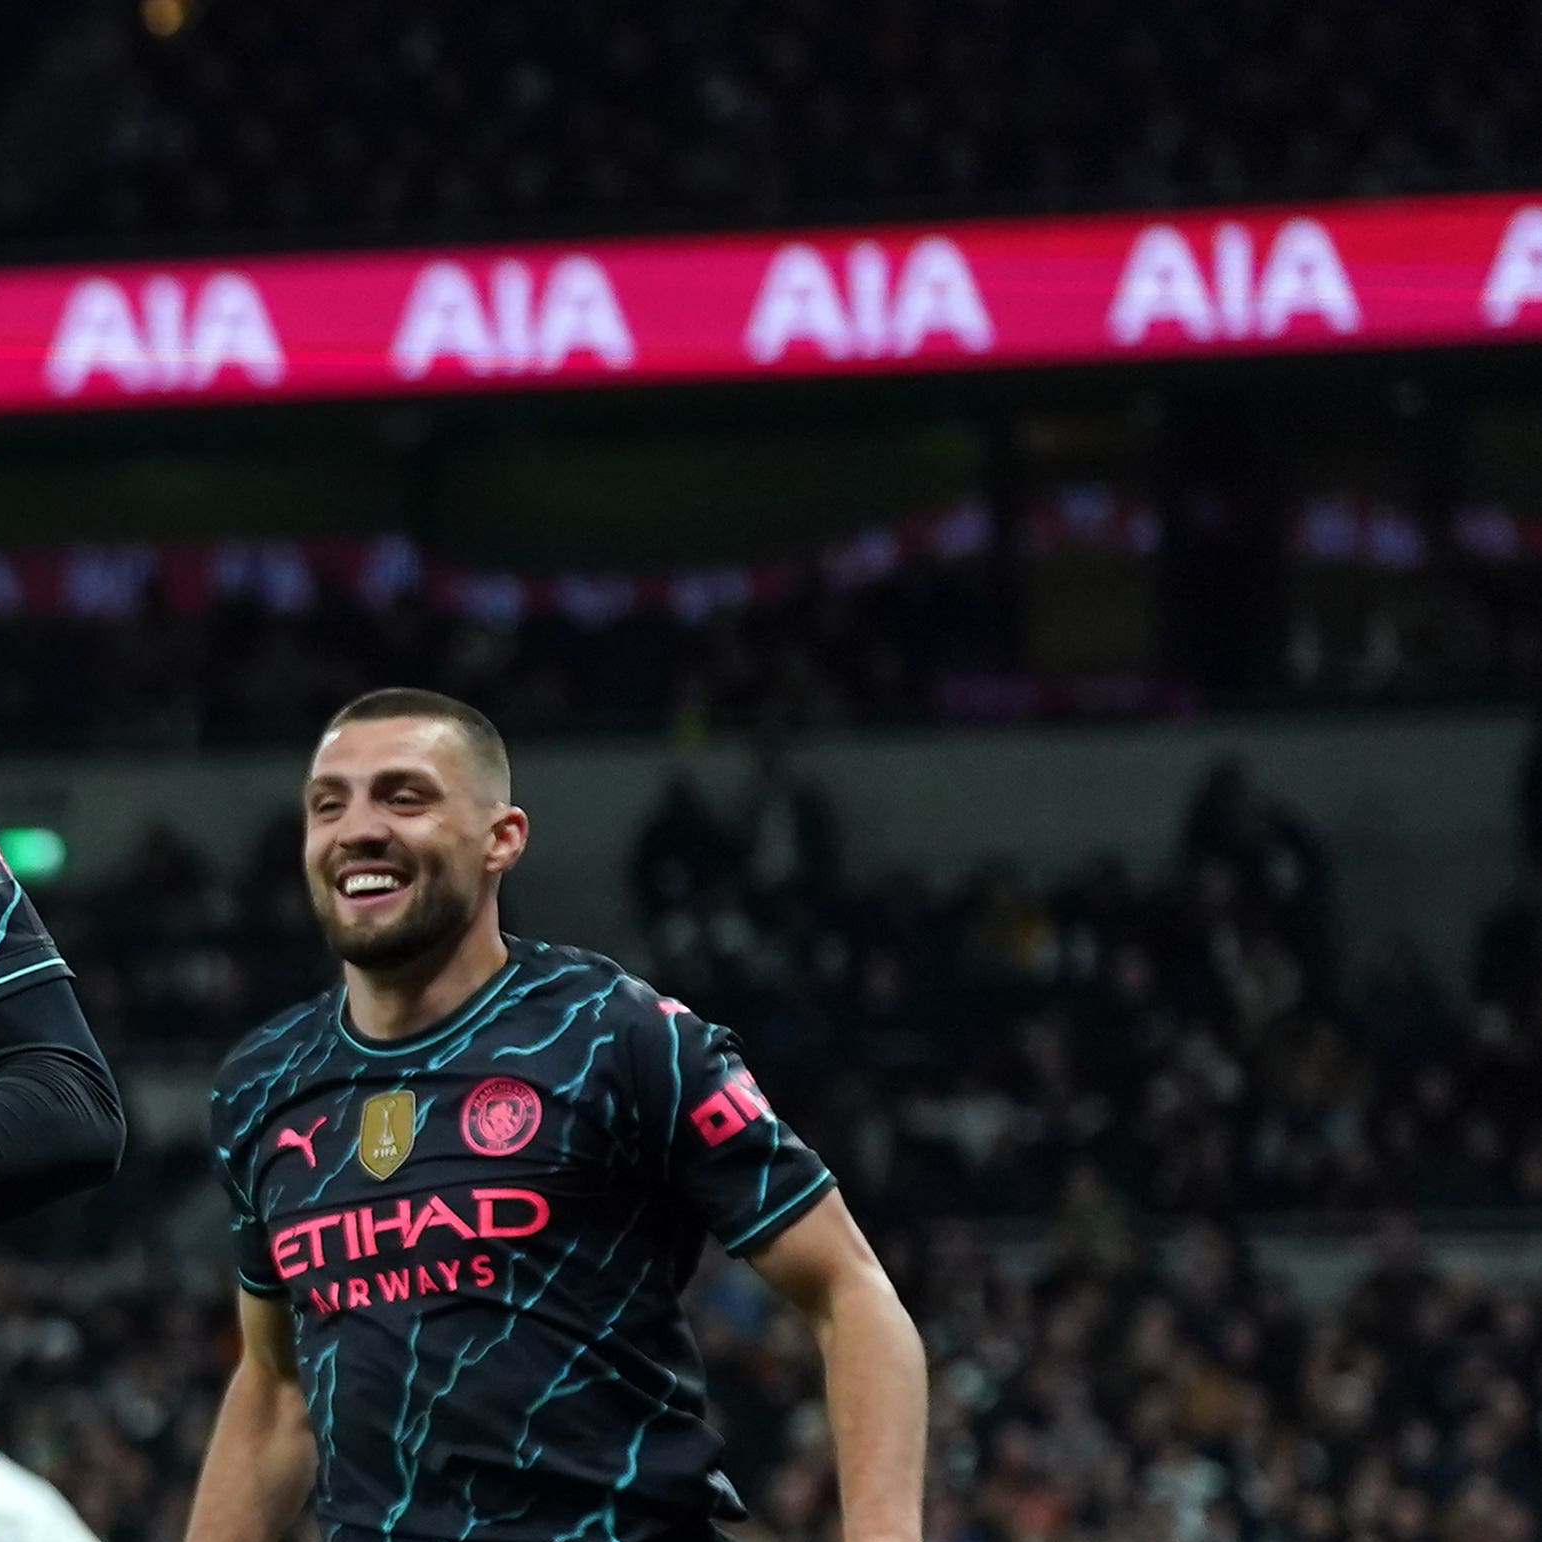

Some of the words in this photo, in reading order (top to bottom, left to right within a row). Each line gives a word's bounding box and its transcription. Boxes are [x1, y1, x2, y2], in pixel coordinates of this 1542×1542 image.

[44, 271, 286, 396] AIA
[391, 253, 638, 382] AIA
[744, 235, 996, 364] AIA
[1108, 215, 1362, 346] AIA
[271, 1187, 551, 1281] ETIHAD
